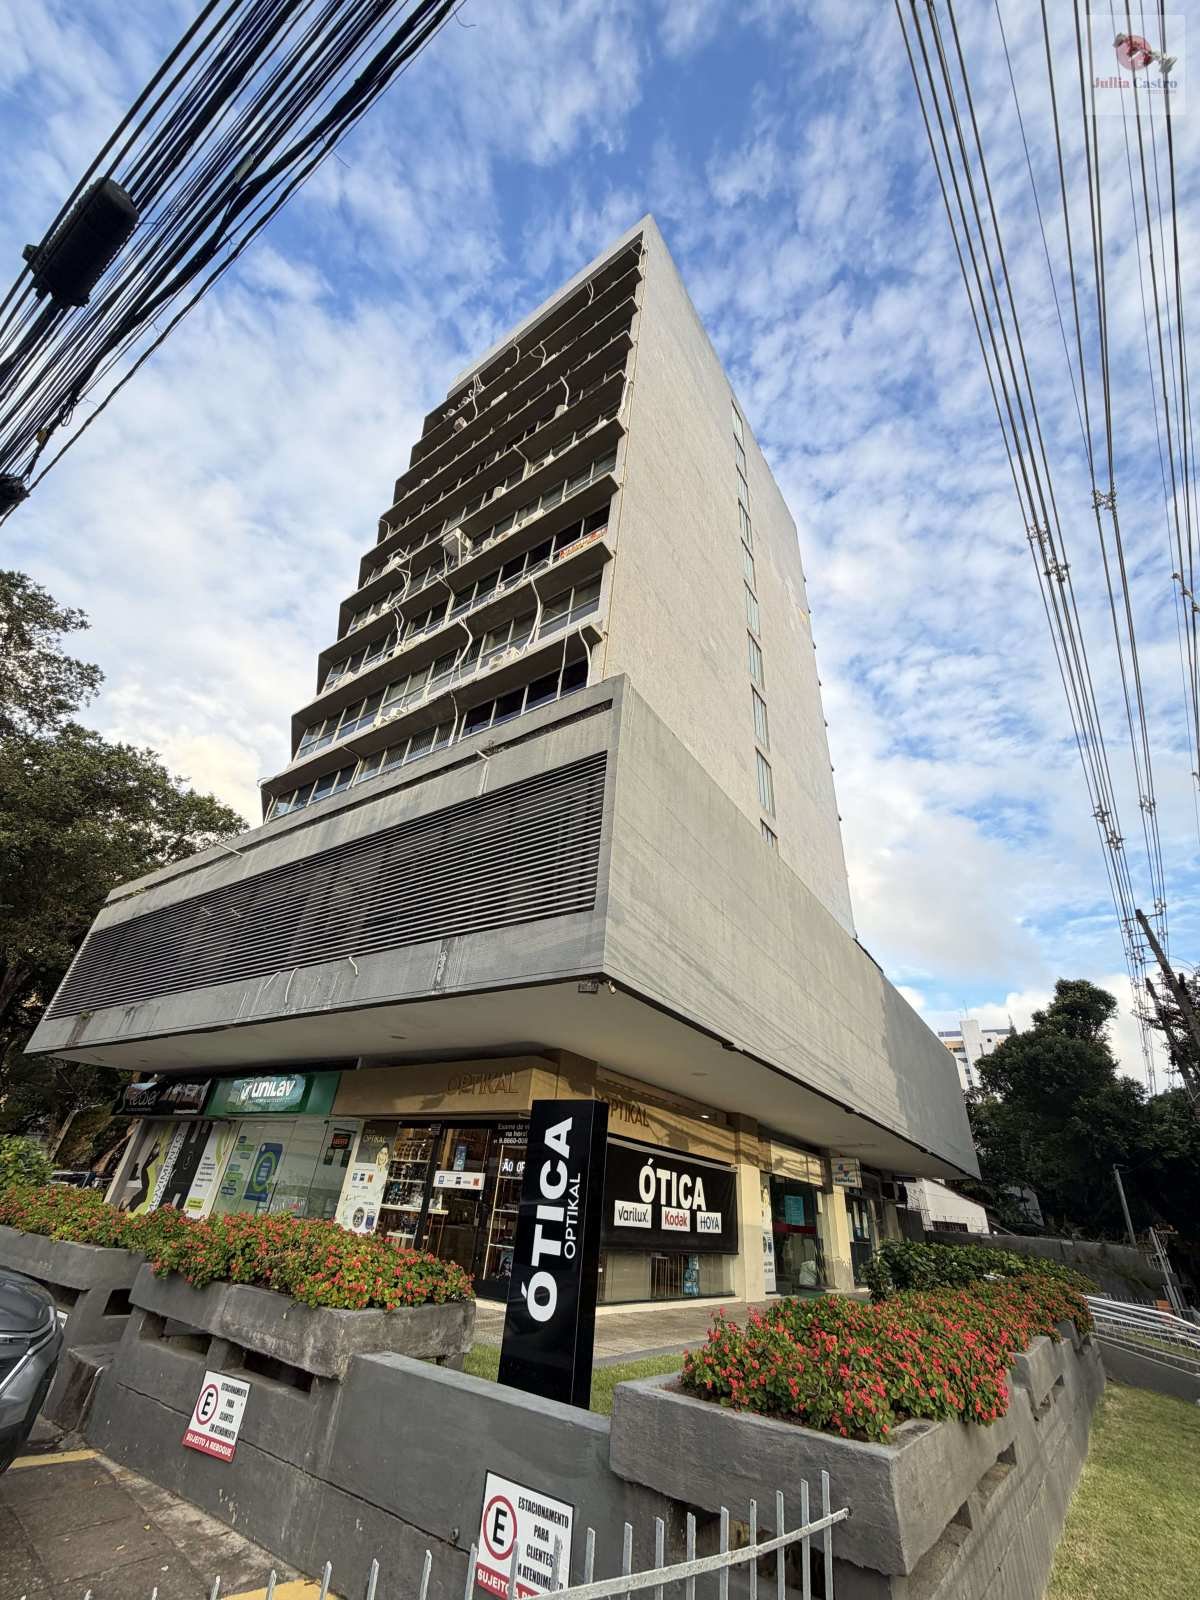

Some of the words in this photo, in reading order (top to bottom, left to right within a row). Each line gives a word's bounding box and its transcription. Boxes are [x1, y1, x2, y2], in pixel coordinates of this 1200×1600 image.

[608, 1099, 650, 1127] PTIKAL
[638, 1157, 707, 1212] ÓTICA
[521, 1117, 573, 1322] ÓTICA
[564, 1173, 581, 1260] OPTIKAL
[664, 1210, 688, 1228] Kodak
[700, 1215, 720, 1230] HOYA
[201, 1392, 213, 1416] E
[186, 1433, 206, 1446] SUJEITO
[210, 1442, 232, 1456] REBOQUE
[518, 1497, 568, 1528] ESTACIONAMENTO
[493, 1507, 507, 1546] E
[534, 1525, 549, 1542] PARA
[526, 1545, 554, 1568] CLIENTES
